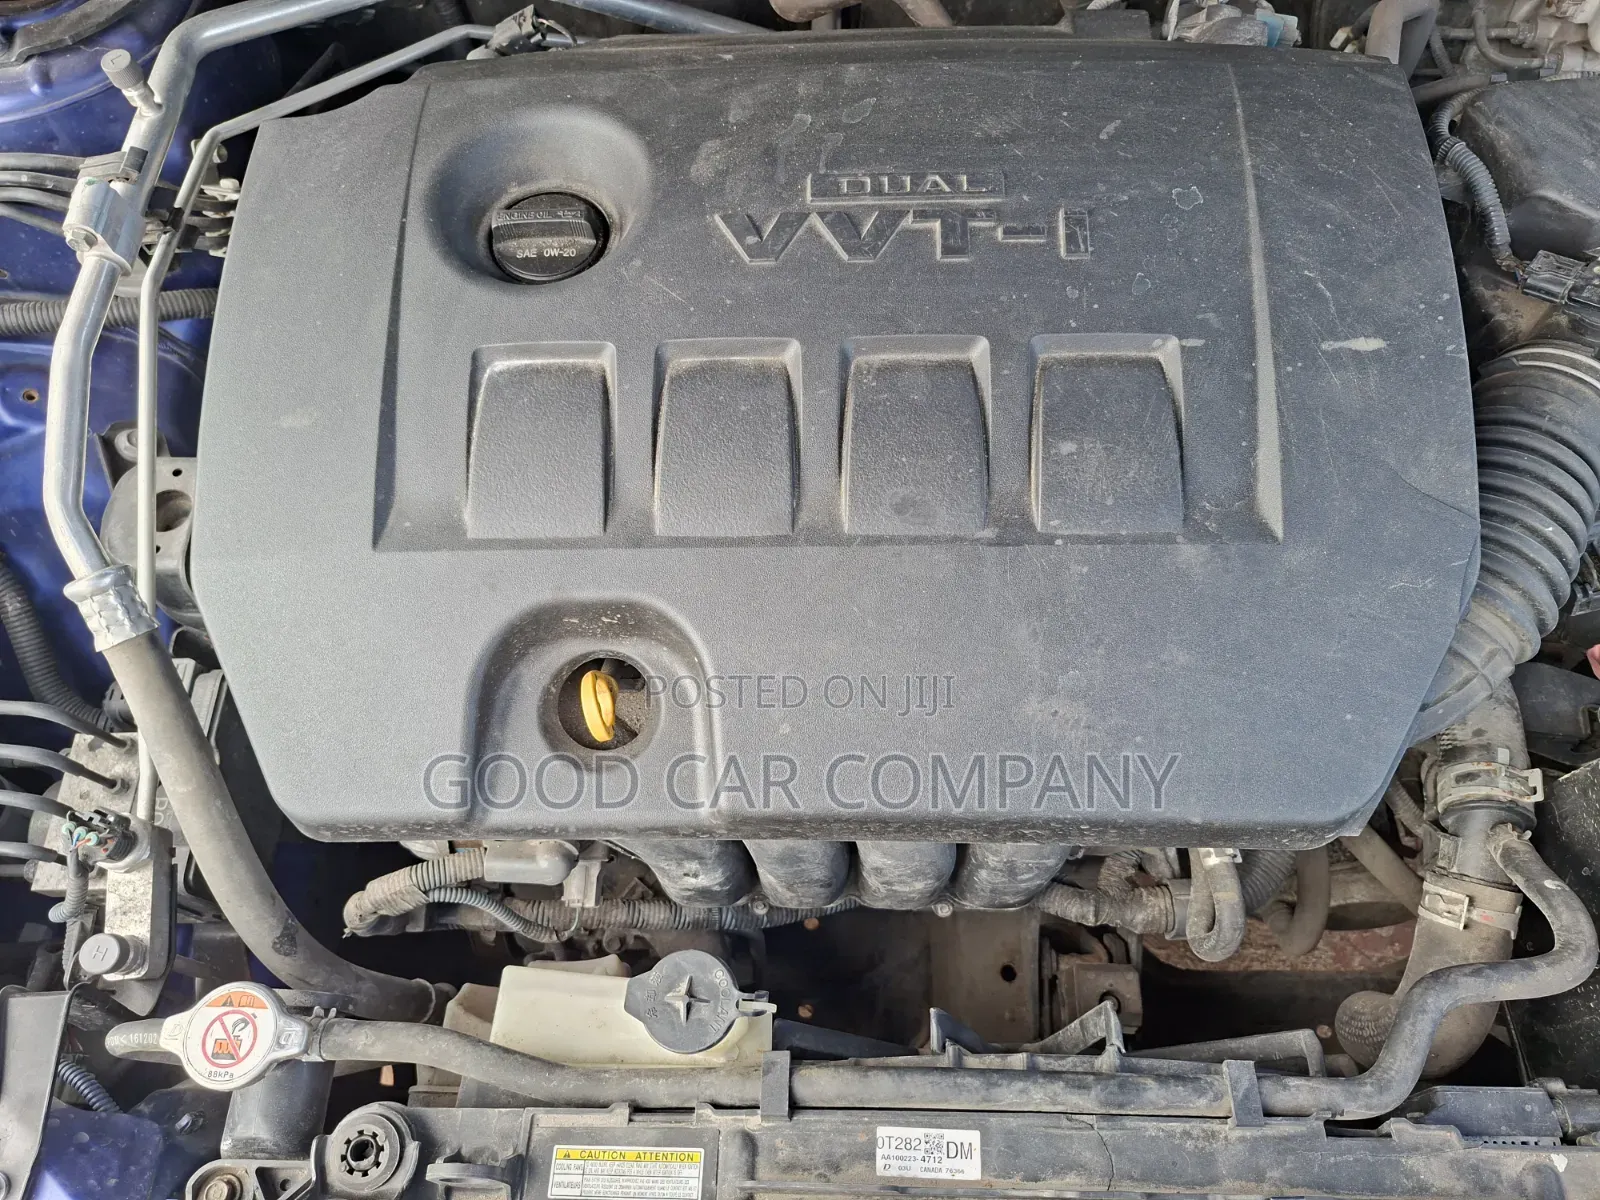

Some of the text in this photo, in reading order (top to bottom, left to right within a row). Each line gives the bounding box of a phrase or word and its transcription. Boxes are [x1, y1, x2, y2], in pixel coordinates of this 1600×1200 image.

[838, 173, 986, 194] DUAL
[497, 210, 554, 221] ENGINE OIL
[516, 248, 577, 259] SAE 0W-20
[92, 945, 109, 962] H
[709, 968, 732, 1036] COOLANT
[207, 1070, 235, 1079] 88kPa
[579, 1150, 695, 1162] CAUTION ATTENTION
[946, 1141, 973, 1160] DM
